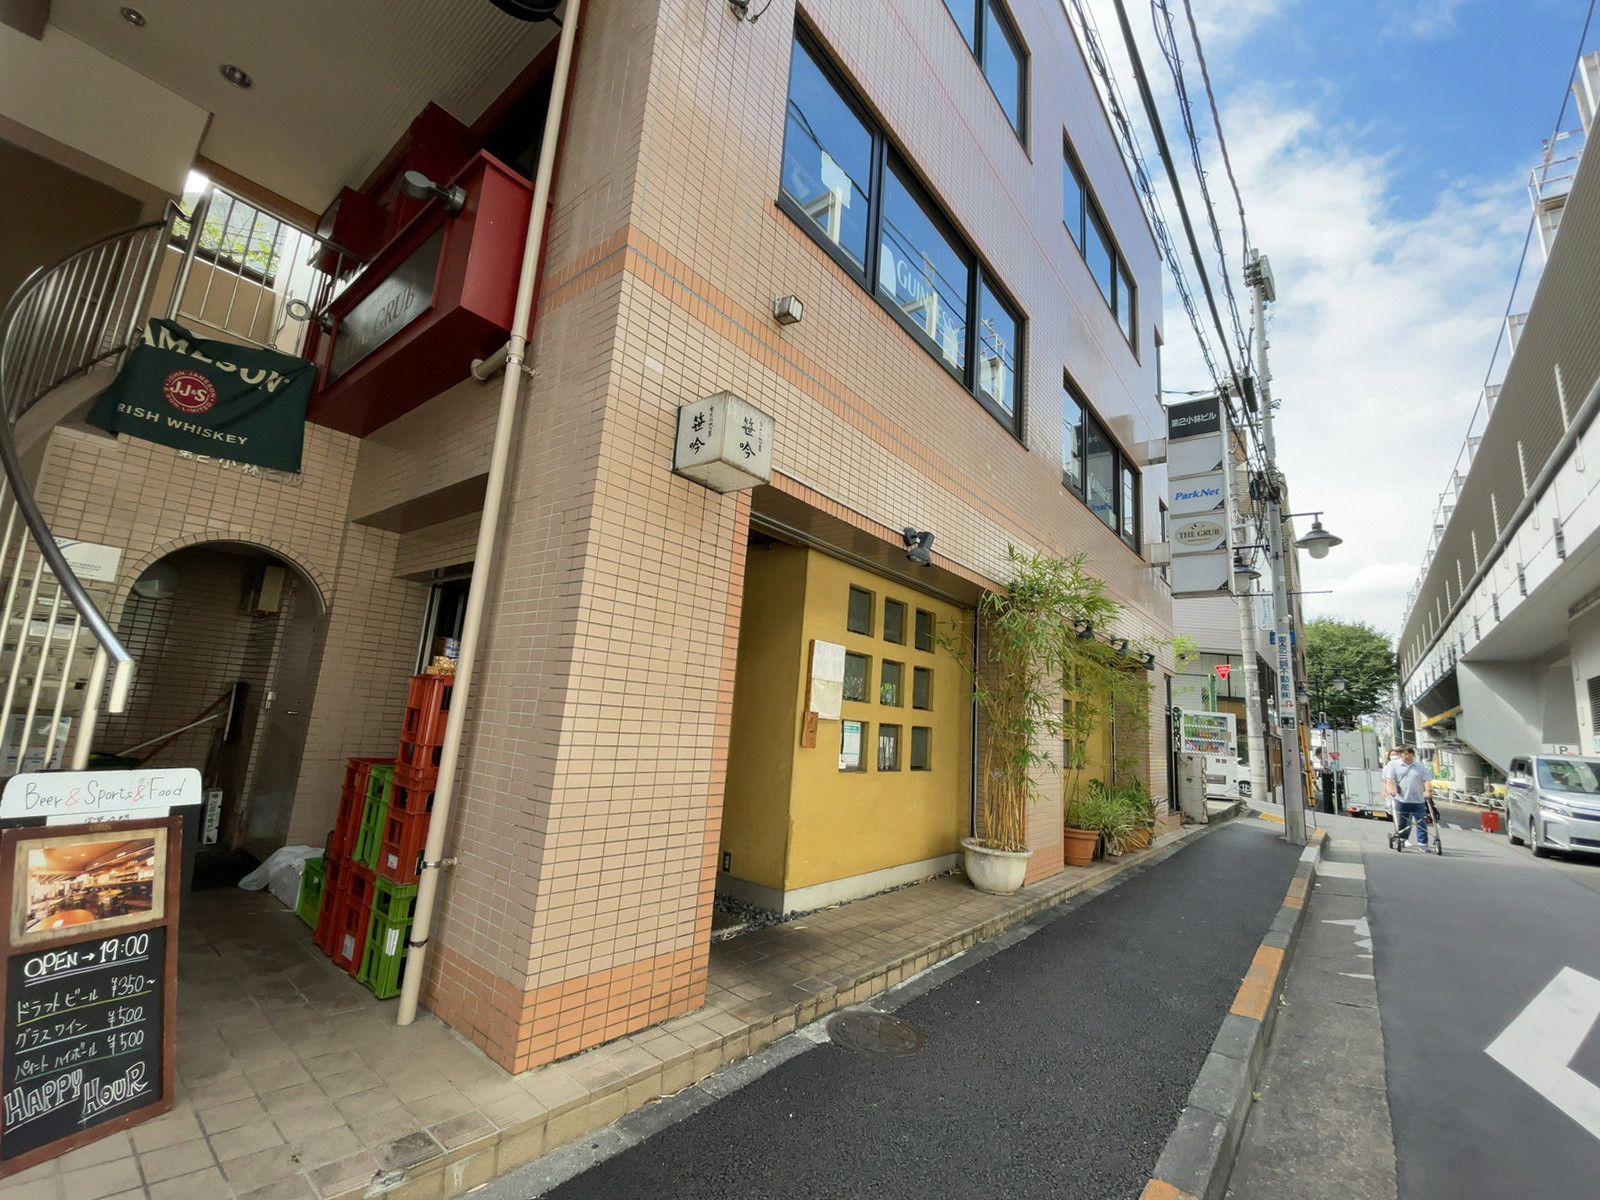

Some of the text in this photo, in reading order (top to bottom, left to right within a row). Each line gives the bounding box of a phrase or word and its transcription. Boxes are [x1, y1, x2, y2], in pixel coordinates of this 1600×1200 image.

[167, 417, 249, 446] WHISKEY
[740, 416, 756, 460] 笹吟
[1179, 528, 1220, 539] THE GRUB
[24, 933, 149, 978] OPEN 19:00
[4, 1061, 149, 1126] HAPPY HOUR
